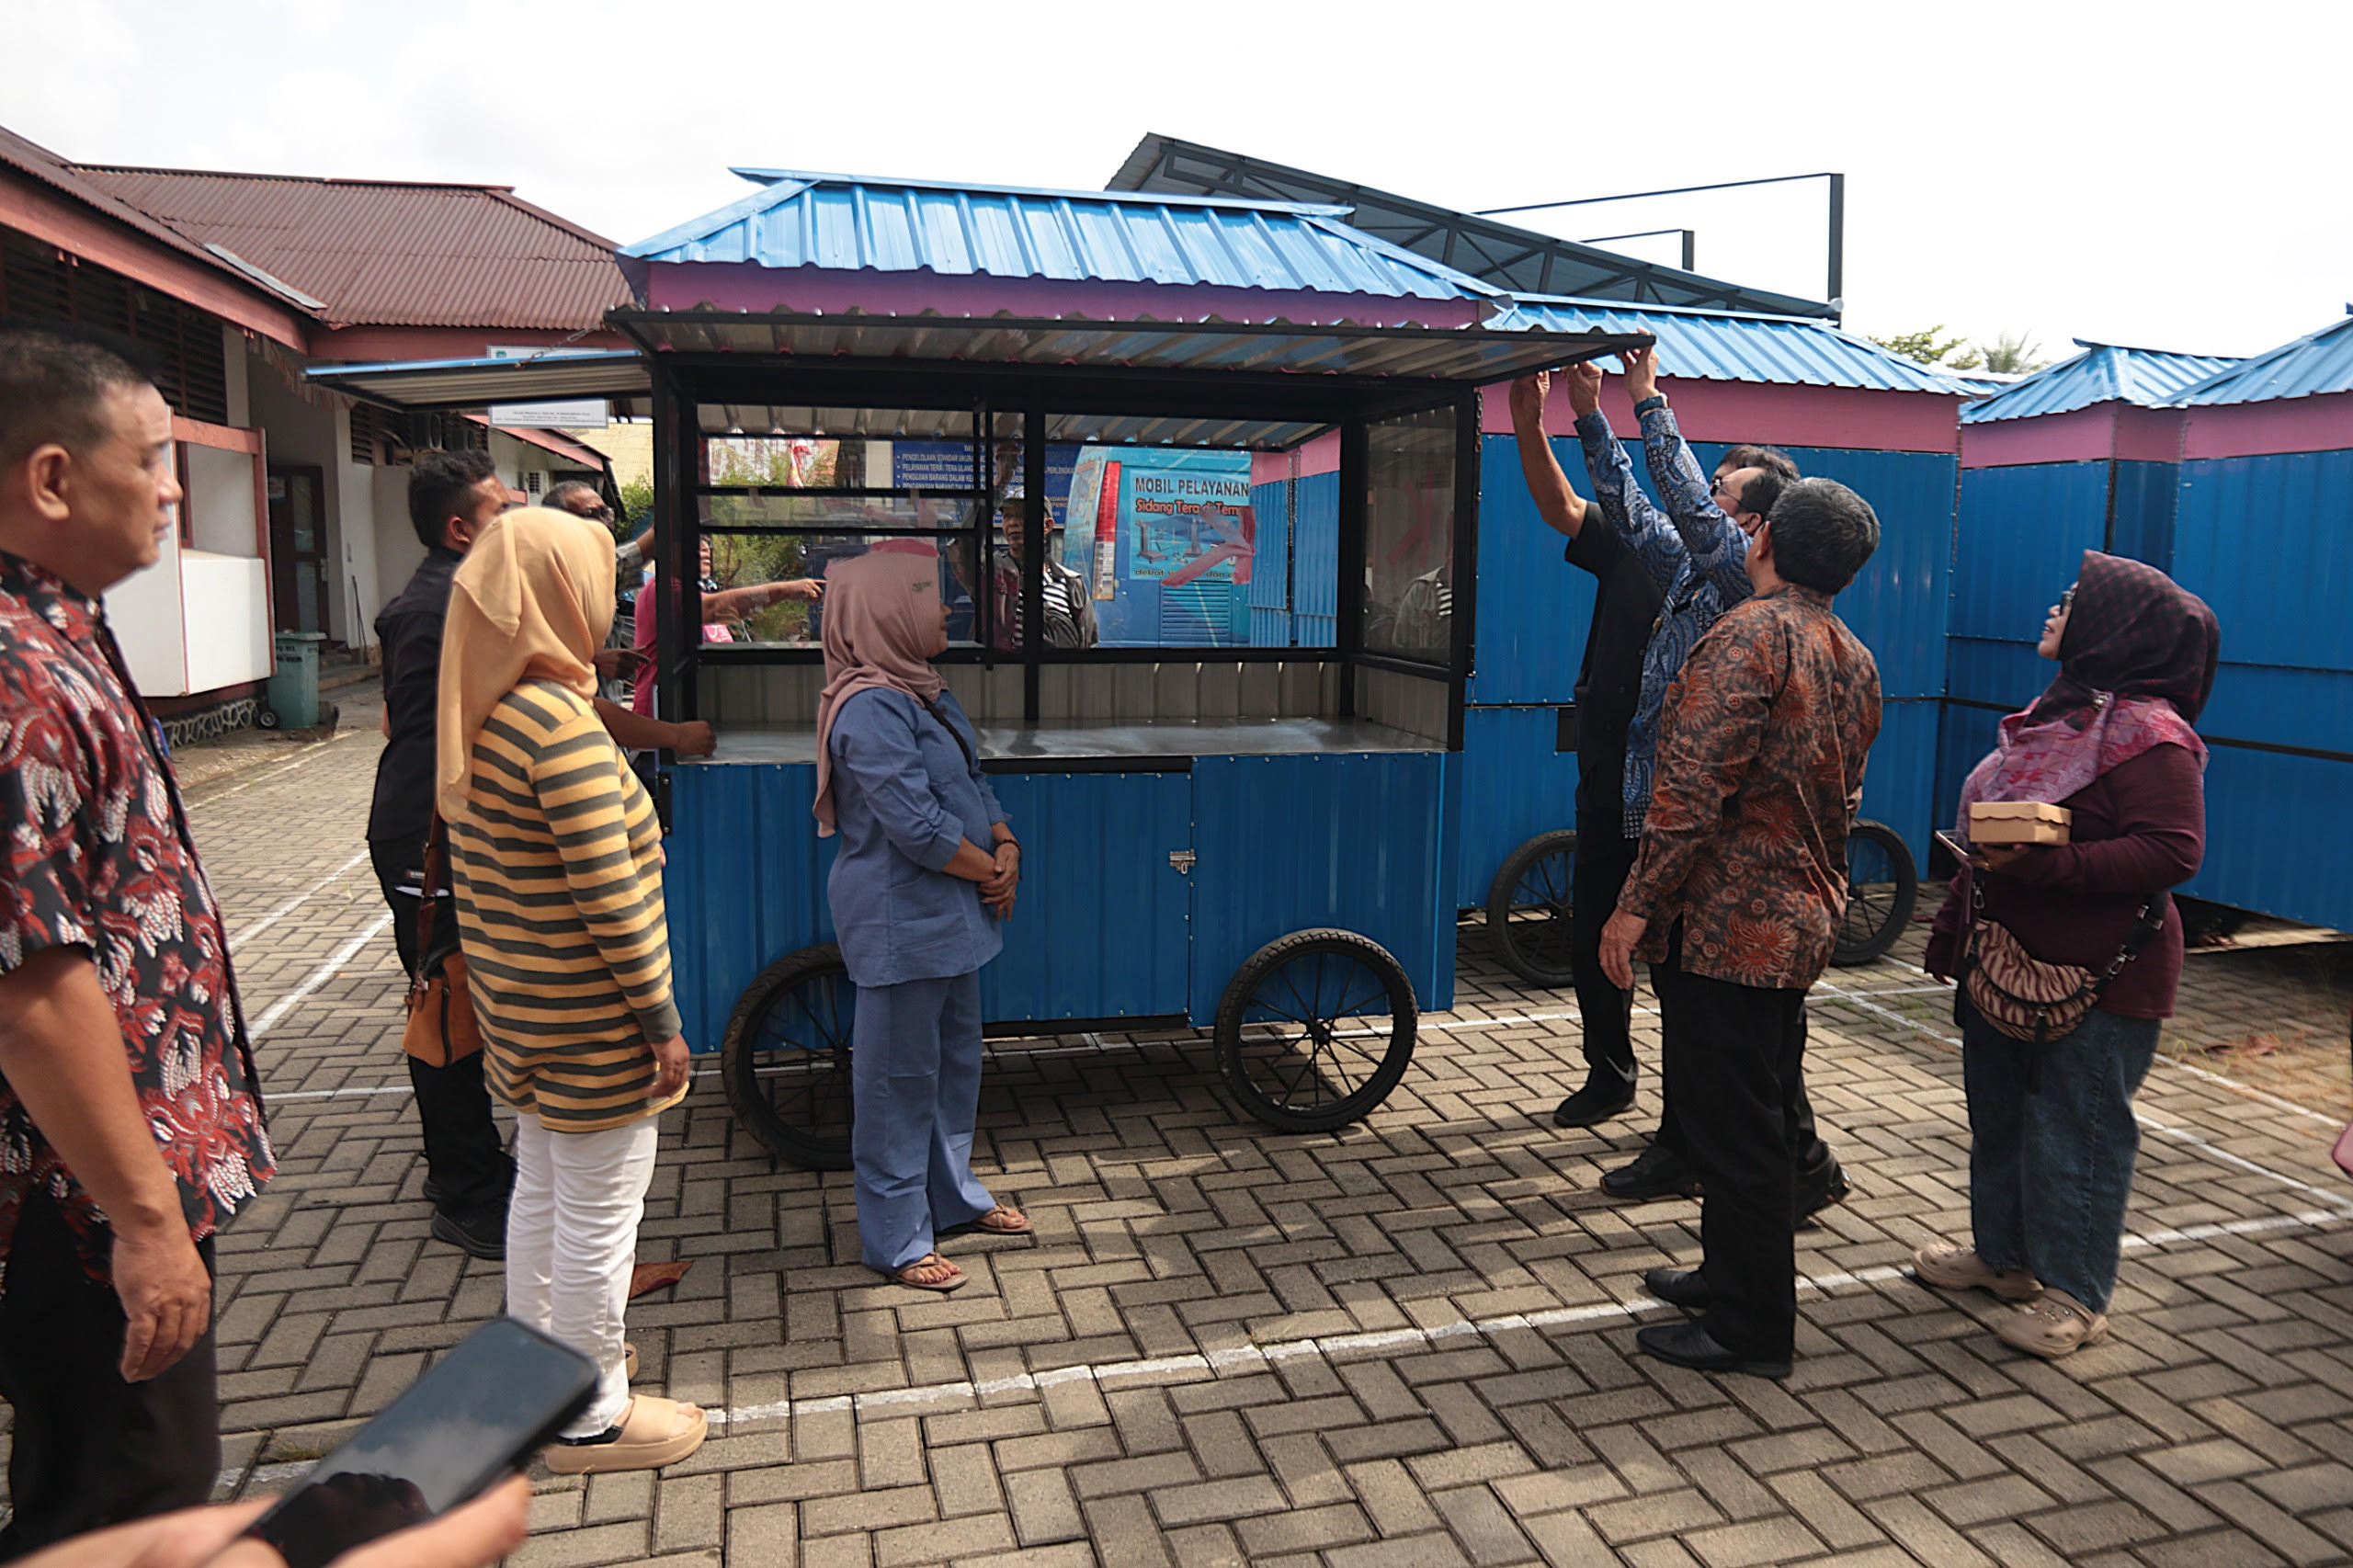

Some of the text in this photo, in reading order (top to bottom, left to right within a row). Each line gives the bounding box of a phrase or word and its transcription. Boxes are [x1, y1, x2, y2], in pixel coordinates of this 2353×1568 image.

[945, 464, 957, 472] TERA
[1135, 477, 1249, 496] MOBIL PELAYANAN
[1135, 497, 1174, 516] Sidang
[1175, 500, 1200, 515] Tera
